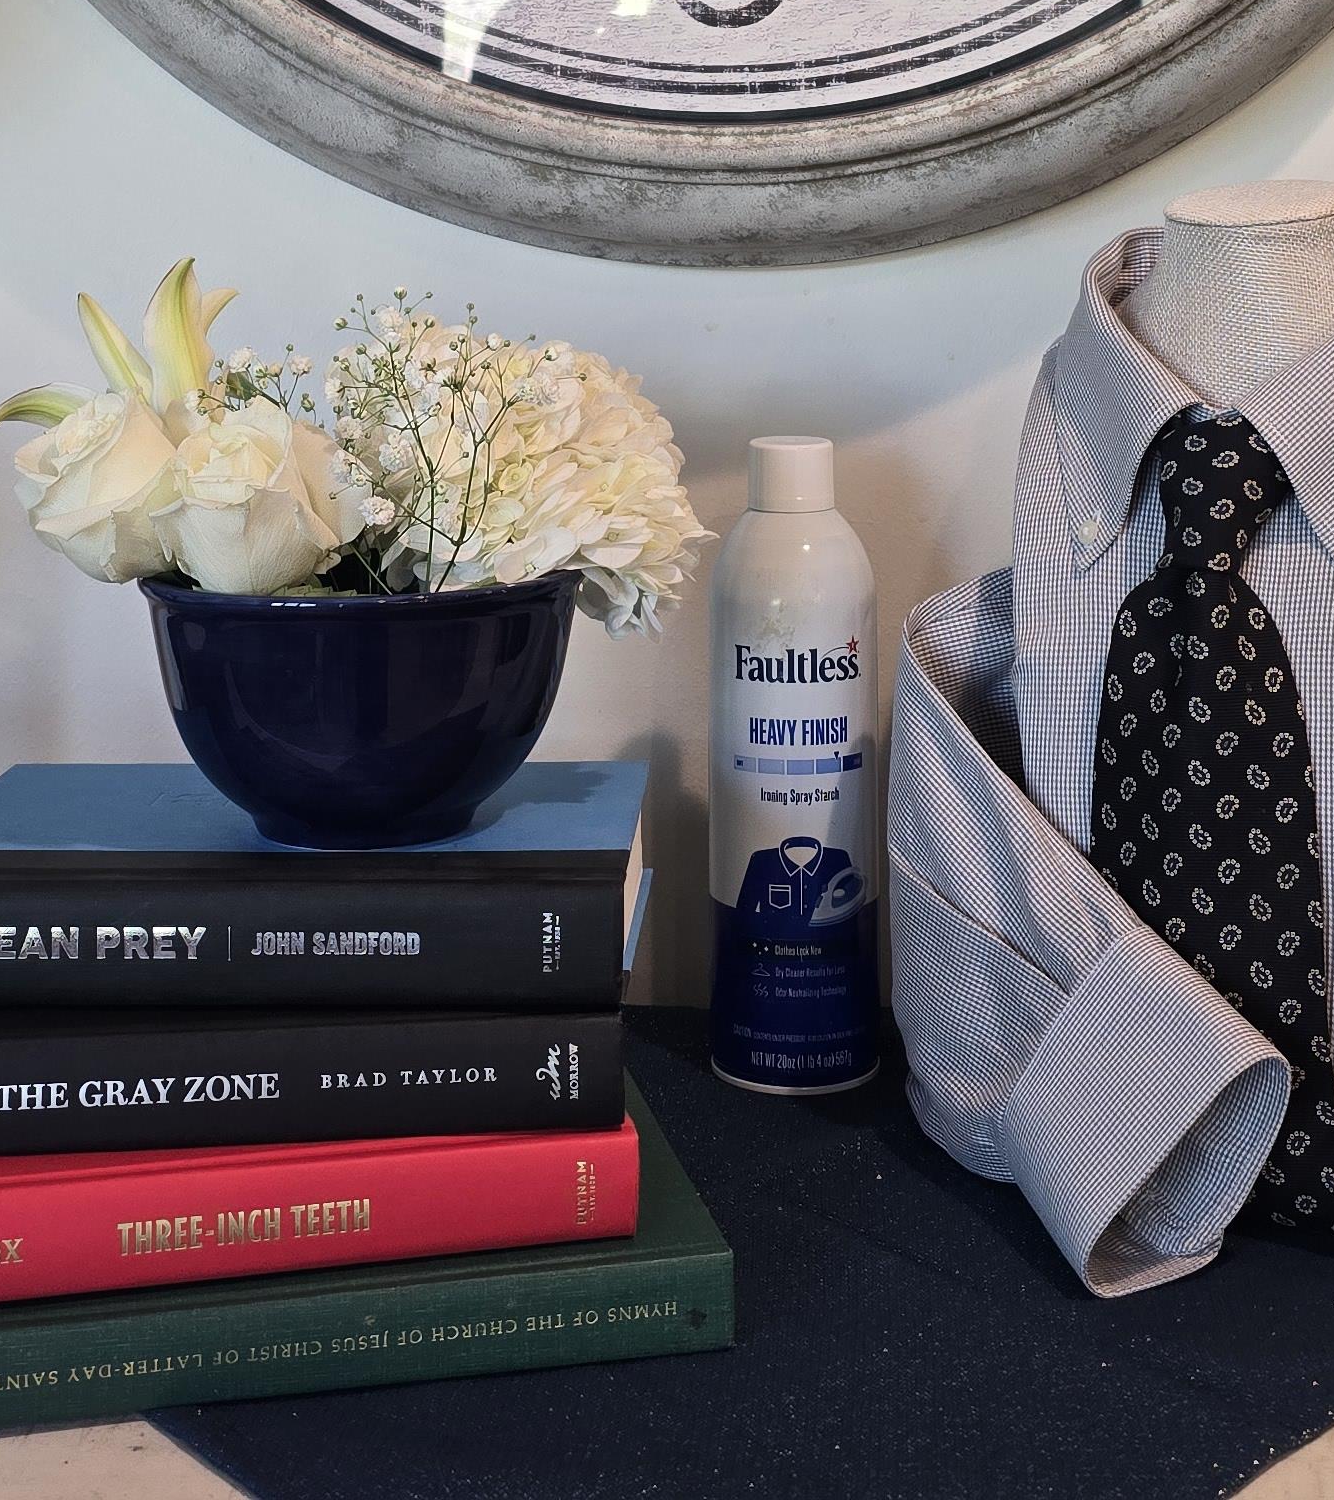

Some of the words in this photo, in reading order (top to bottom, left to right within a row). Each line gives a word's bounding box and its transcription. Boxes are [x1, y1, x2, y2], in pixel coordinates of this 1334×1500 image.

[734, 643, 860, 683] Faultless
[749, 716, 797, 746] HEAVY
[802, 715, 848, 746] FINISH
[760, 787, 788, 806] Ironing
[790, 788, 813, 806] Spray
[814, 786, 840, 803] Starch
[96, 925, 207, 960] PREY
[251, 931, 304, 956] JOHN
[312, 931, 421, 956] SANDFORD
[542, 912, 553, 973] PUTNAM
[568, 1042, 579, 1100] MORROW
[751, 1051, 763, 1066] NET
[764, 1052, 776, 1068] WT
[777, 1054, 796, 1069] 20oz
[78, 1077, 176, 1108] GRAY
[183, 1072, 280, 1103] ZONE
[320, 1071, 387, 1090] BRAD
[400, 1067, 498, 1087] TAYLOR
[576, 1161, 587, 1225] PUTNAM
[116, 1206, 282, 1257] THREE-INCH
[289, 1197, 371, 1238] TEETH
[526, 1313, 565, 1332] THE
[573, 1310, 599, 1326] OF
[607, 1301, 678, 1323] HYMNS
[331, 1329, 388, 1353] JESUS
[397, 1329, 423, 1346] OF
[431, 1319, 517, 1342] CHURCH
[212, 1350, 239, 1365] OF
[247, 1341, 322, 1362] CHRIST
[68, 1353, 203, 1382] LATTER-DAY
